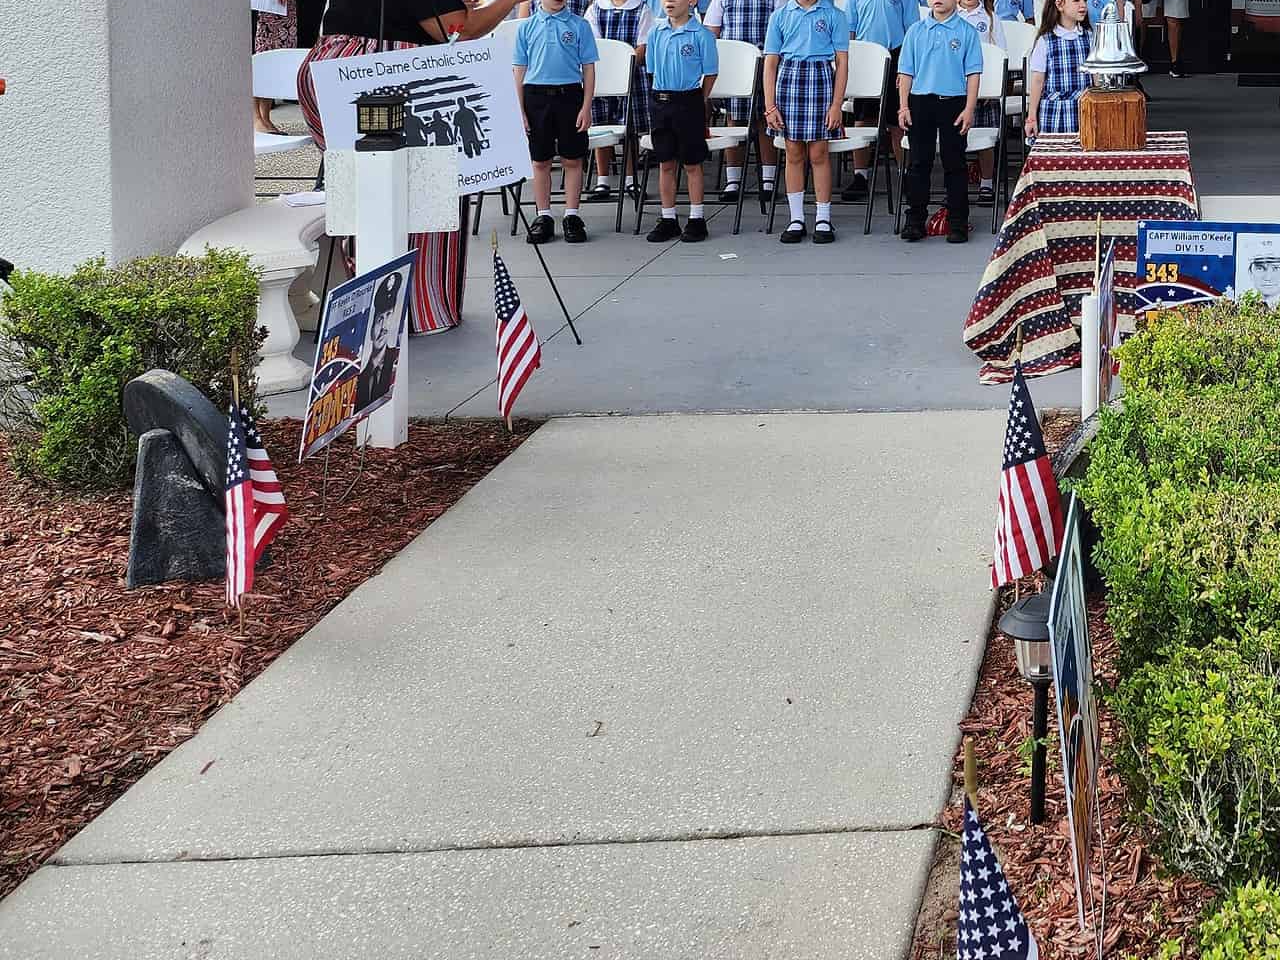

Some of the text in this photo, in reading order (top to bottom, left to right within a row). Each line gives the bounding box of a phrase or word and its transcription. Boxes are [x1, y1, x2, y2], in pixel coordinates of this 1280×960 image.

[338, 48, 491, 82] Notre Dame Catholic School
[457, 164, 514, 187] Responders
[1149, 231, 1232, 242] CAPT William O'Keefe
[1175, 244, 1205, 252] DIV 15
[1145, 263, 1178, 283] 343
[320, 335, 340, 367] 343
[306, 375, 358, 444] FDNY
